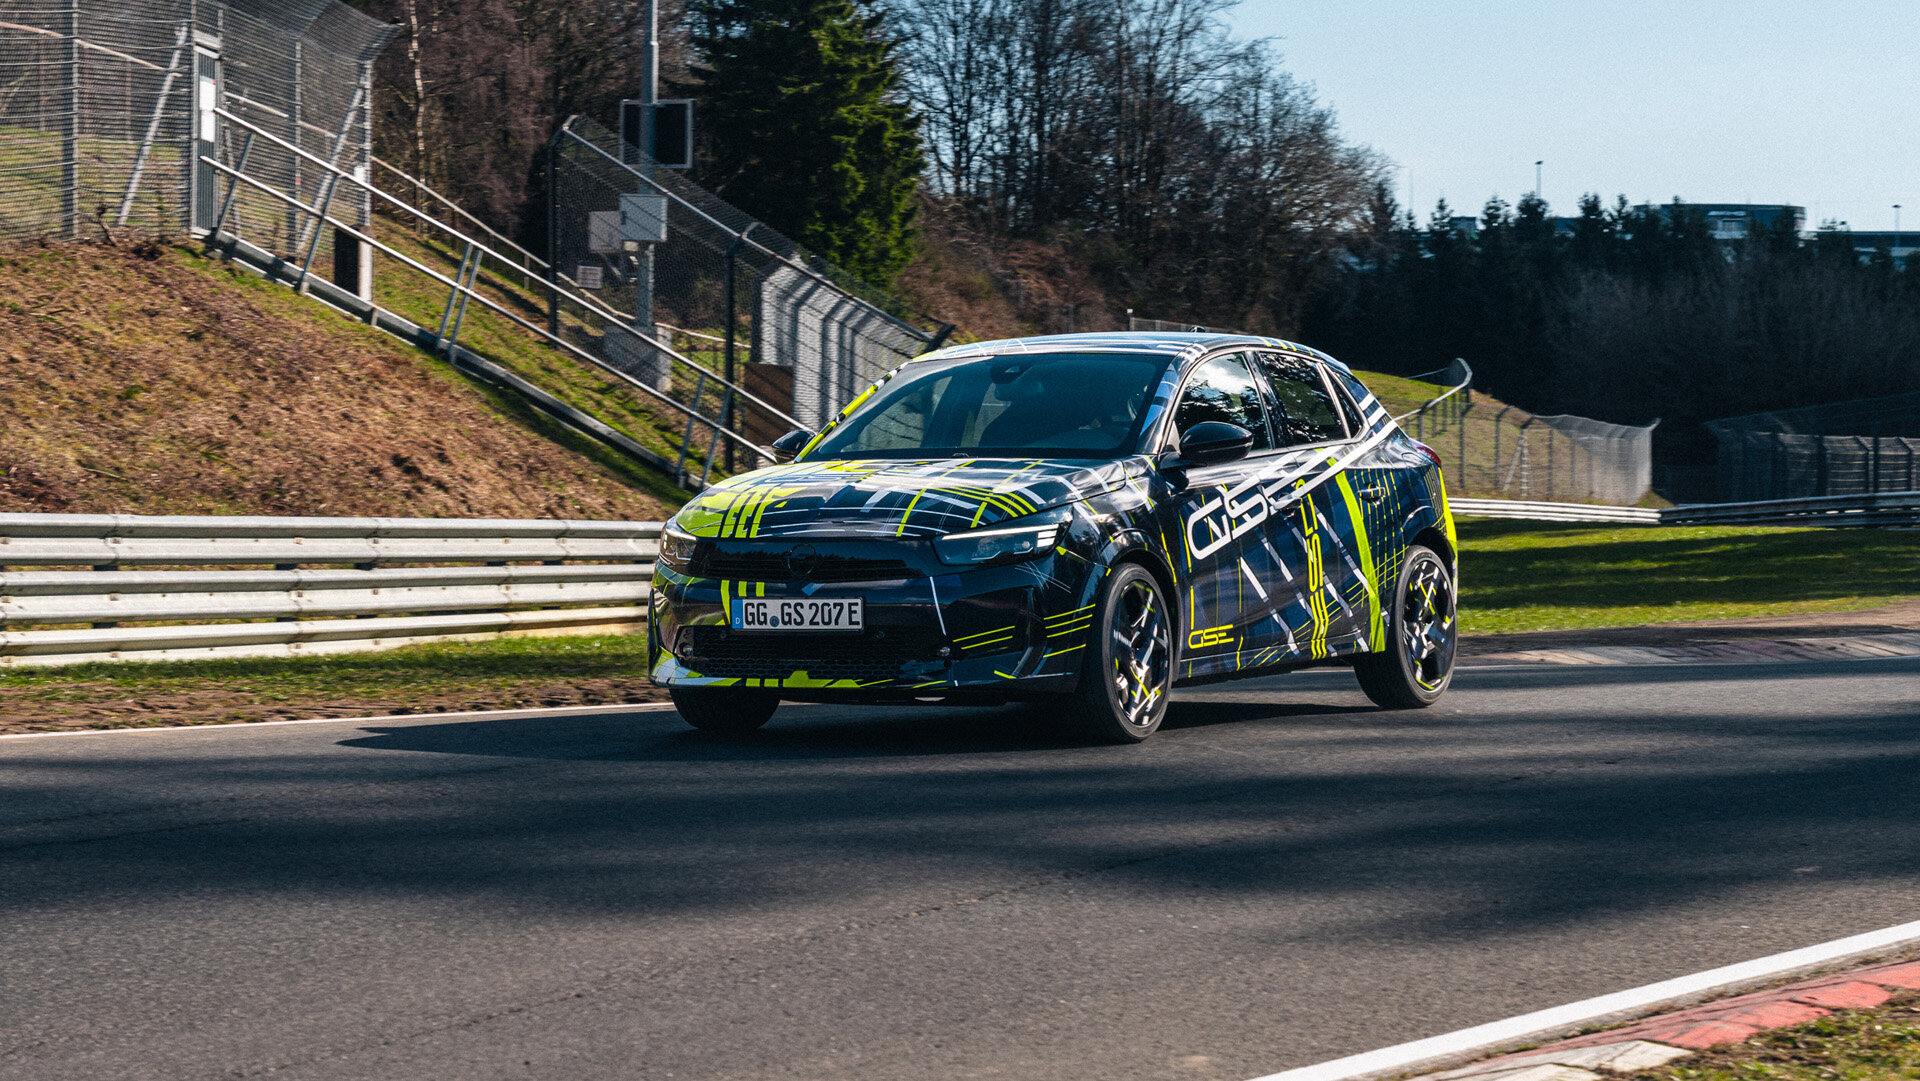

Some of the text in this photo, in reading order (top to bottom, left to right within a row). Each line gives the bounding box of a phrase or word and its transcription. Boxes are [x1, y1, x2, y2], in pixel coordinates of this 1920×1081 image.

[744, 602, 768, 626] GG
[780, 602, 805, 626] GS
[1188, 624, 1235, 650] GSE
